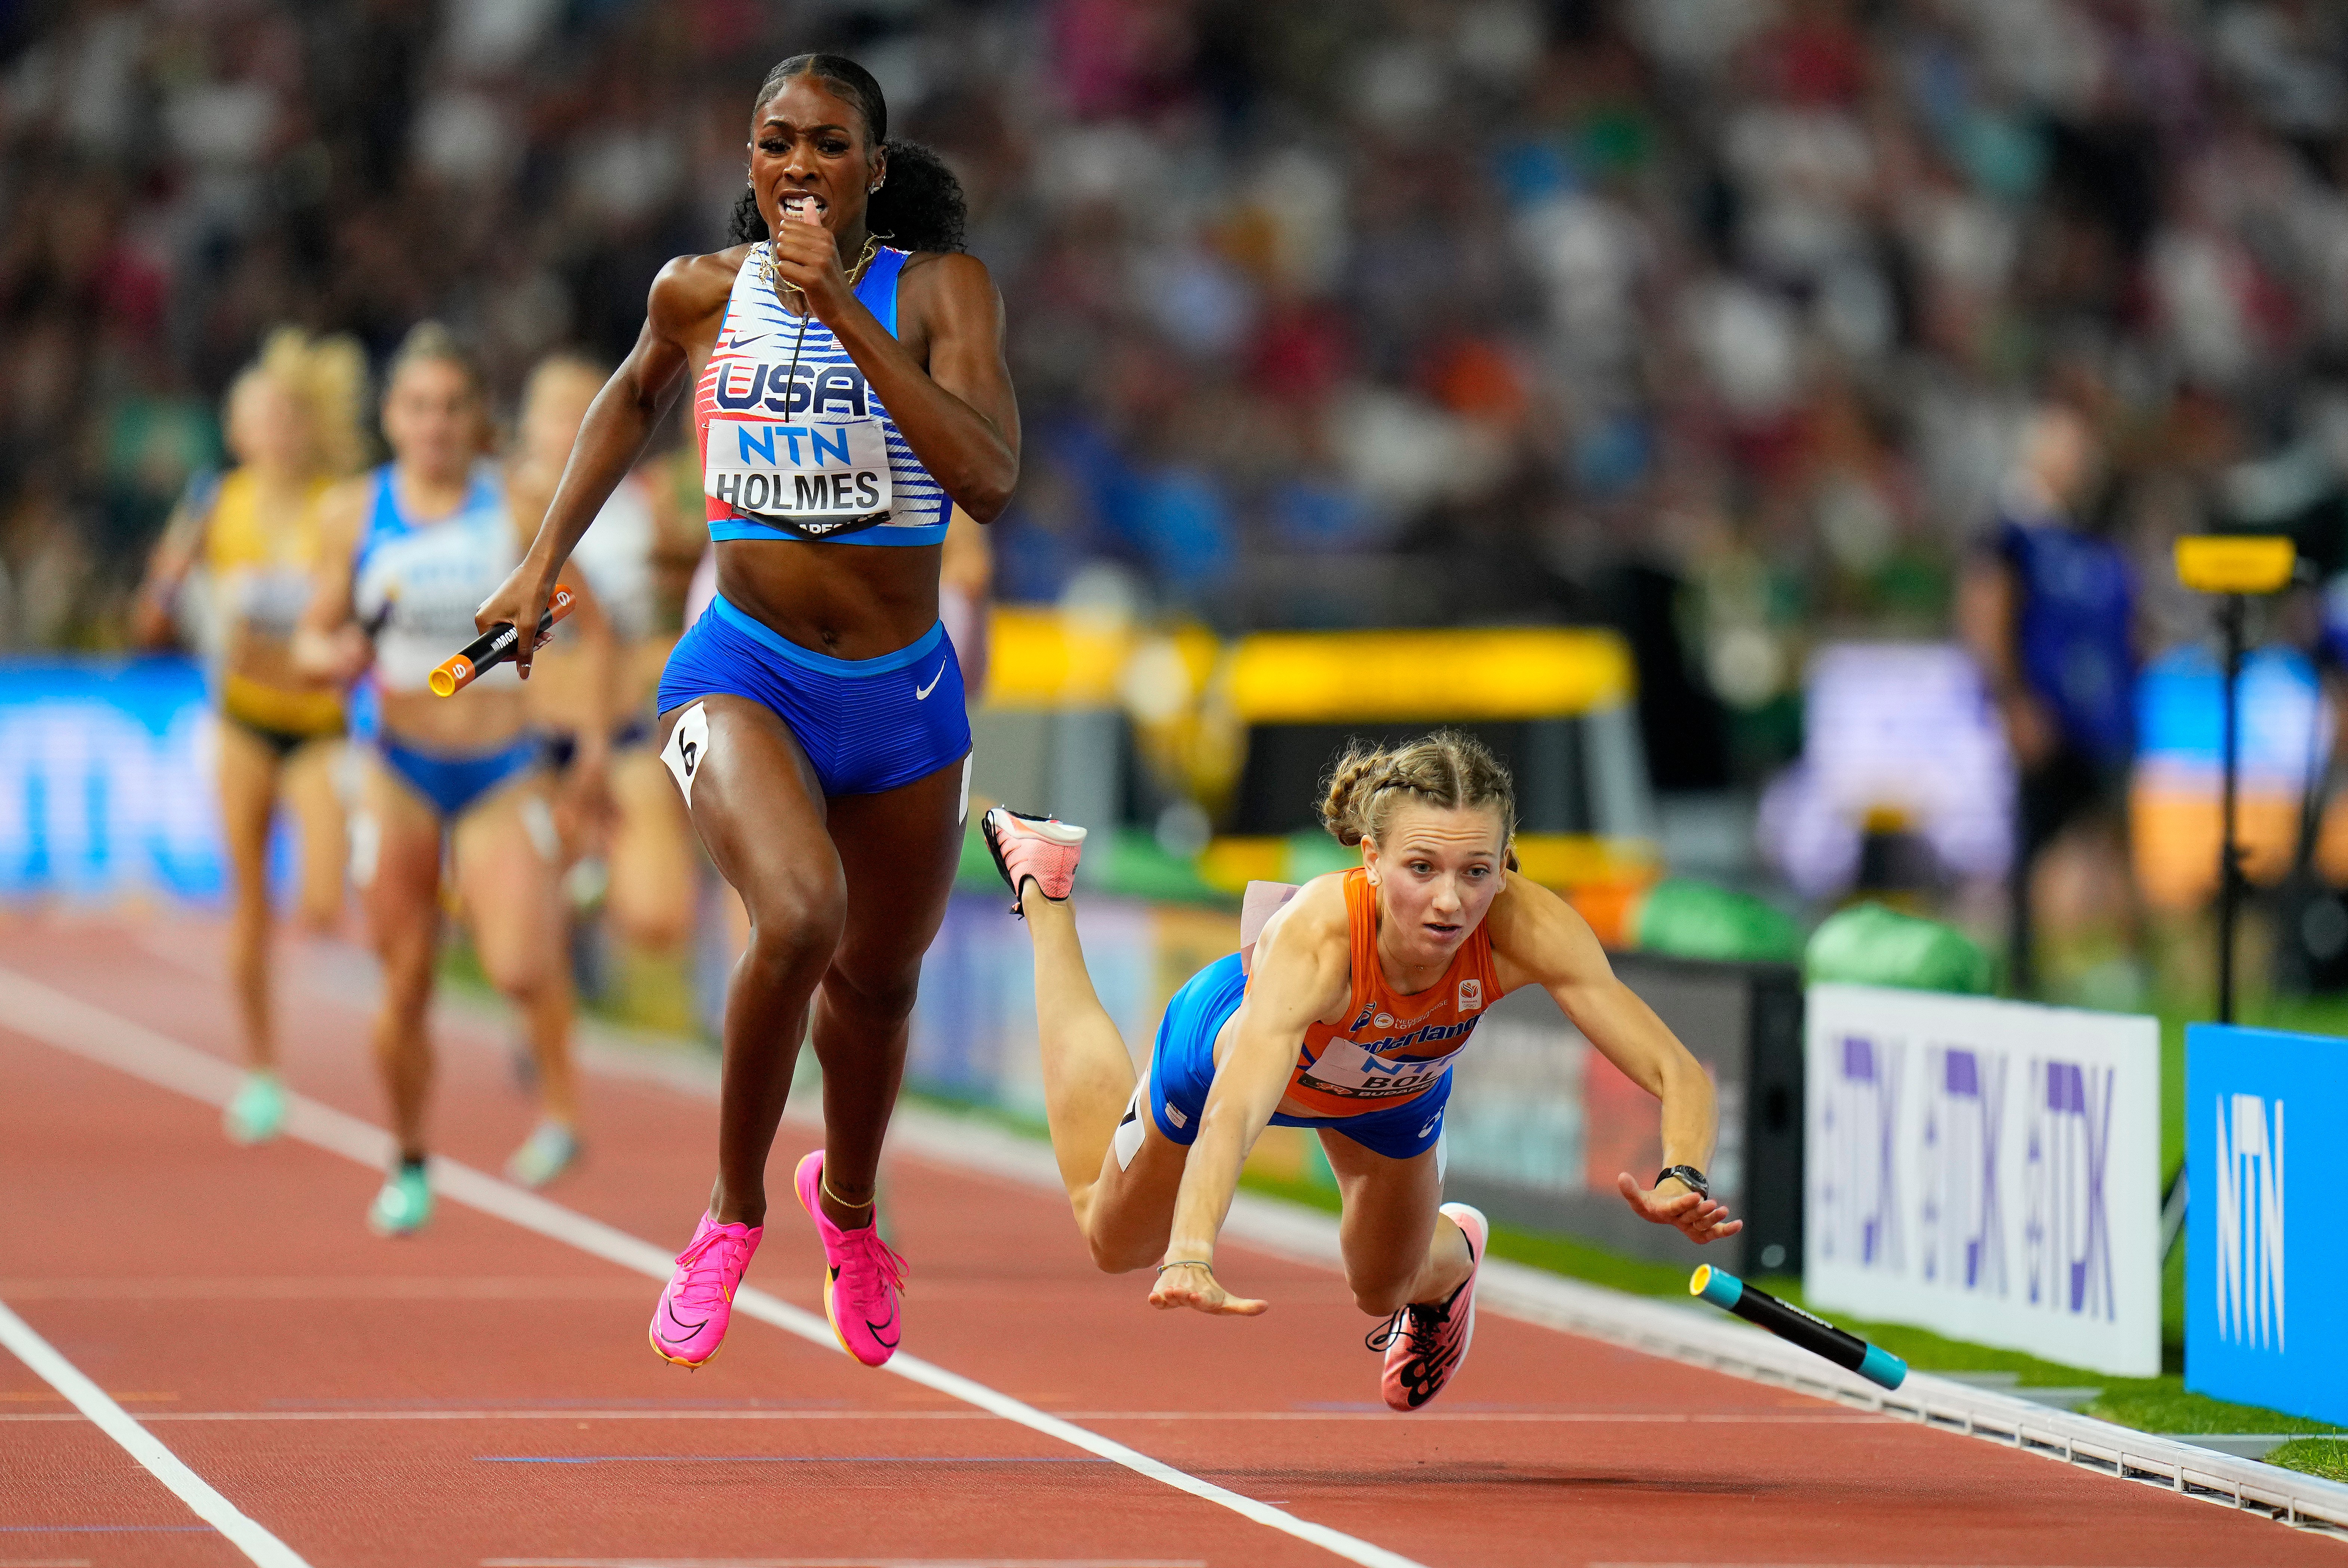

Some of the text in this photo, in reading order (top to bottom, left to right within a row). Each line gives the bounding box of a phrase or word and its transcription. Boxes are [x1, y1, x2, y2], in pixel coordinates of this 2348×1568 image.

[714, 361, 868, 418] USA
[738, 425, 851, 467] NTN
[717, 471, 880, 511] HOLMES
[678, 726, 697, 777] 6
[1361, 1071, 1438, 1088] BOL
[2216, 1092, 2285, 1355] NTN
